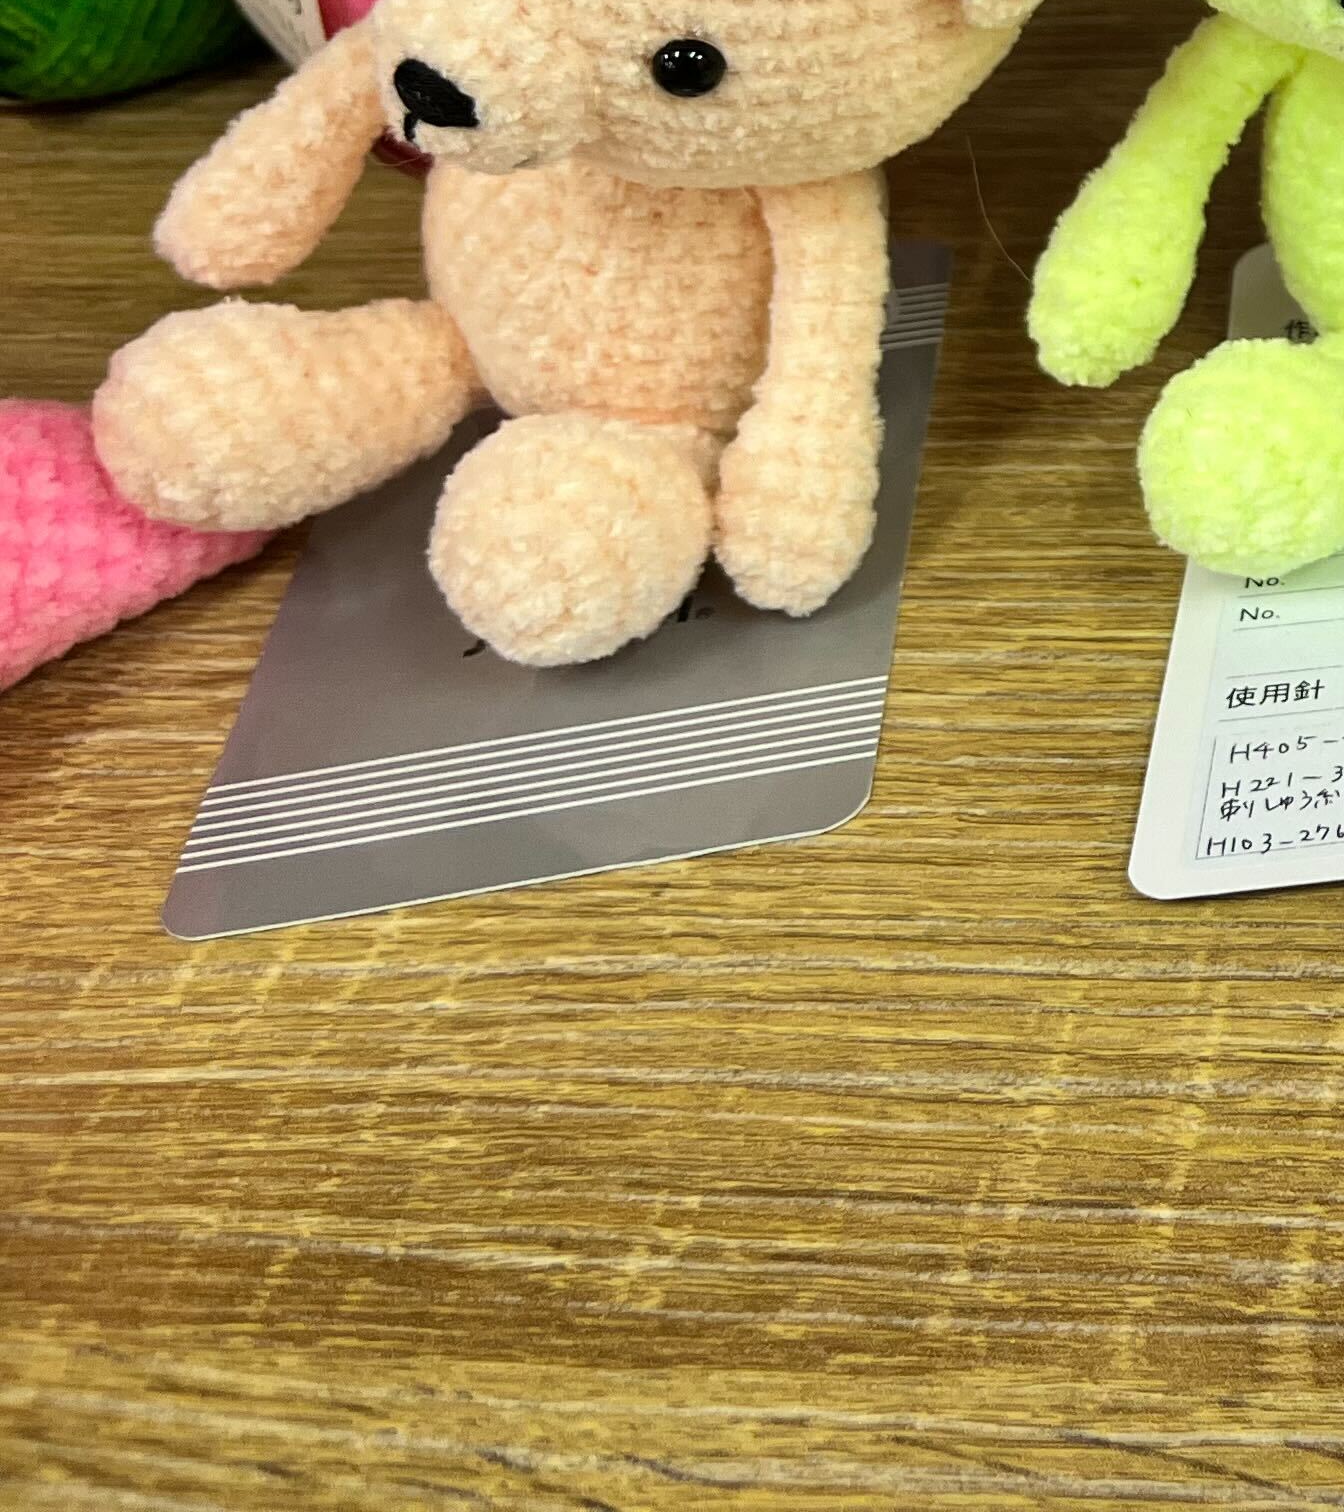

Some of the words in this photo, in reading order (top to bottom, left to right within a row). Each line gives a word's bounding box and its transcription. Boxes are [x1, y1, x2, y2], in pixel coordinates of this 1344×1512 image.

[1239, 606, 1280, 622] No.
[1226, 679, 1325, 710] 使用針
